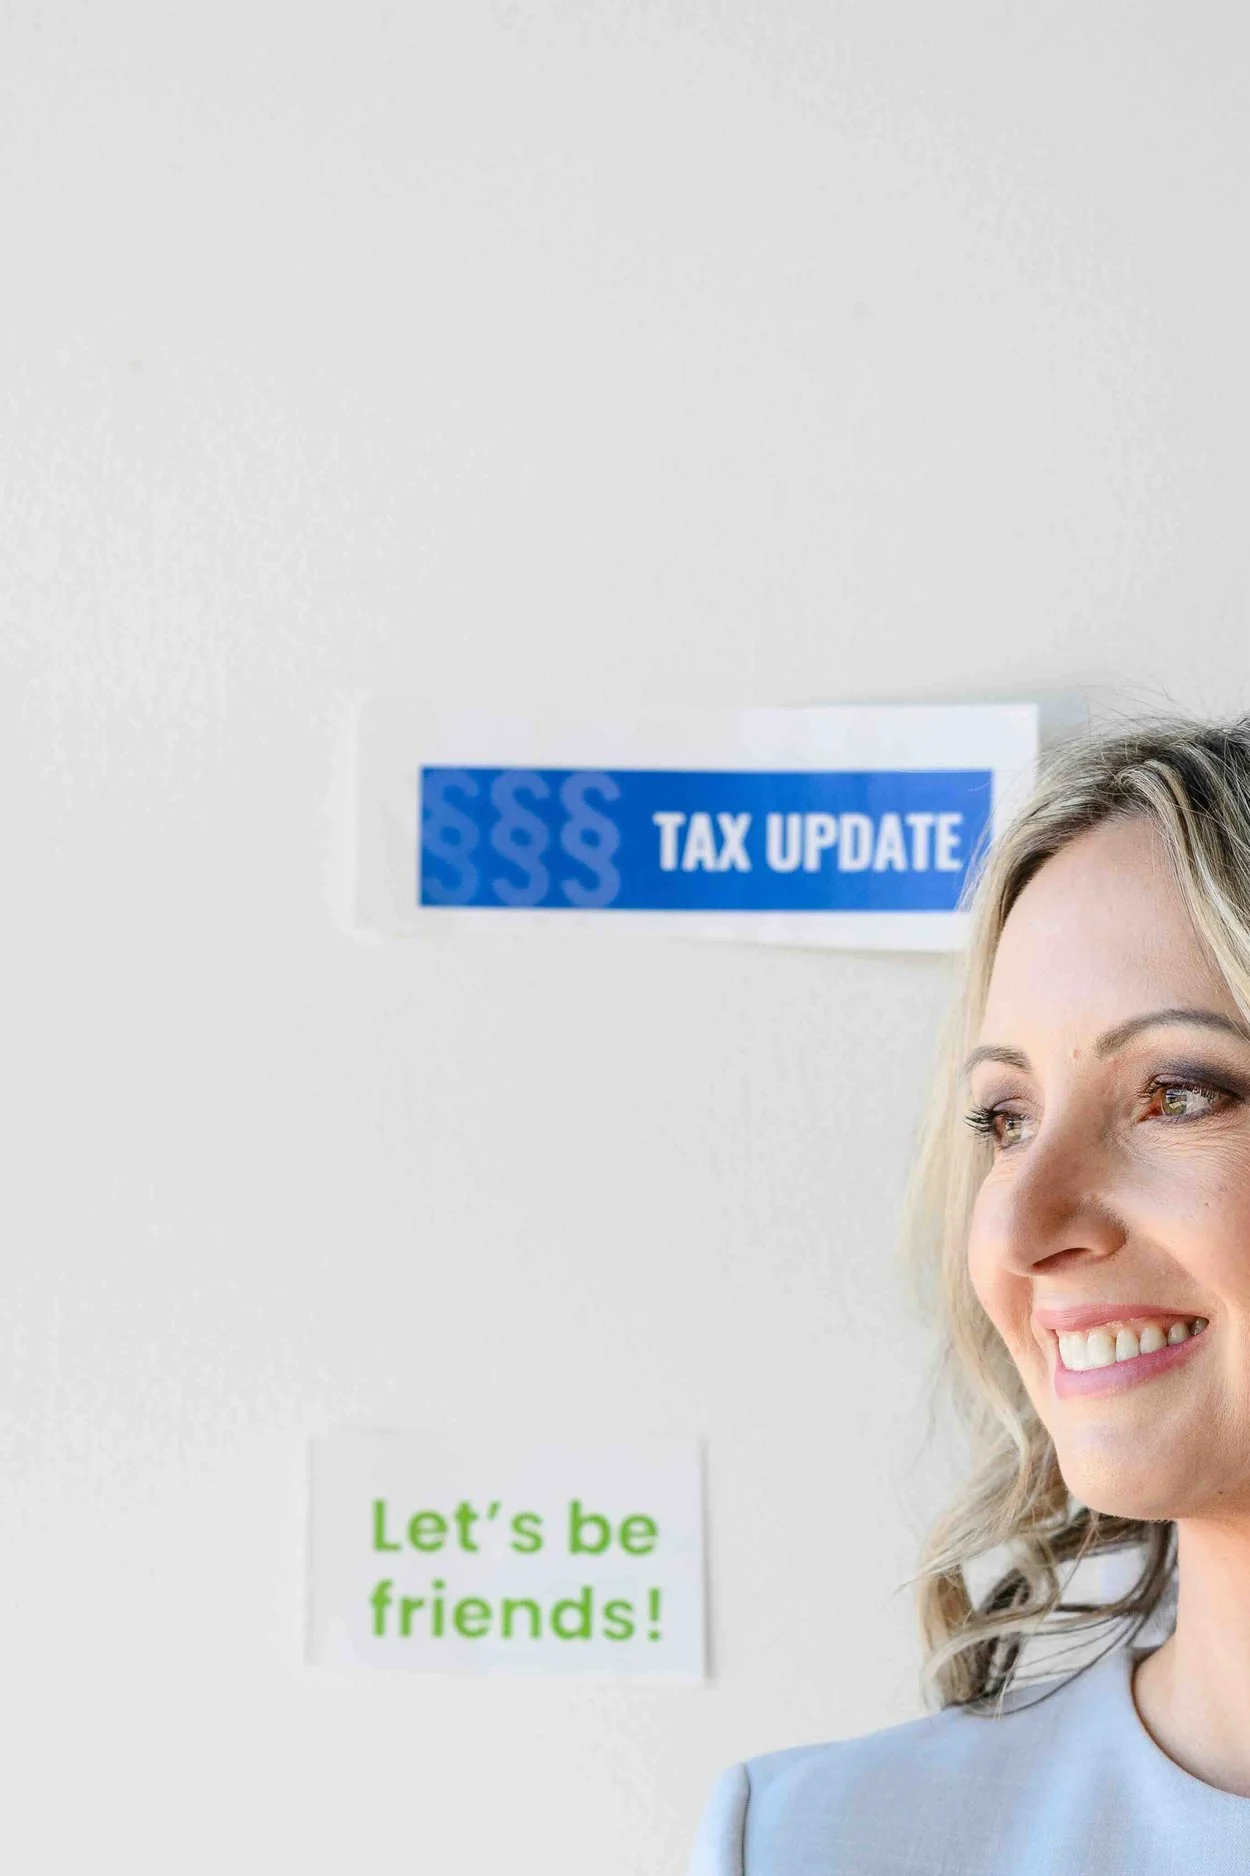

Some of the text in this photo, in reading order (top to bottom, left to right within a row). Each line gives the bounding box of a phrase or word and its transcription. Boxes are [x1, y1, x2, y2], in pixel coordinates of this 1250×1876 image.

[653, 811, 963, 872] TAX UPDATE
[568, 1498, 659, 1557] be
[370, 1578, 662, 1642] friends!
